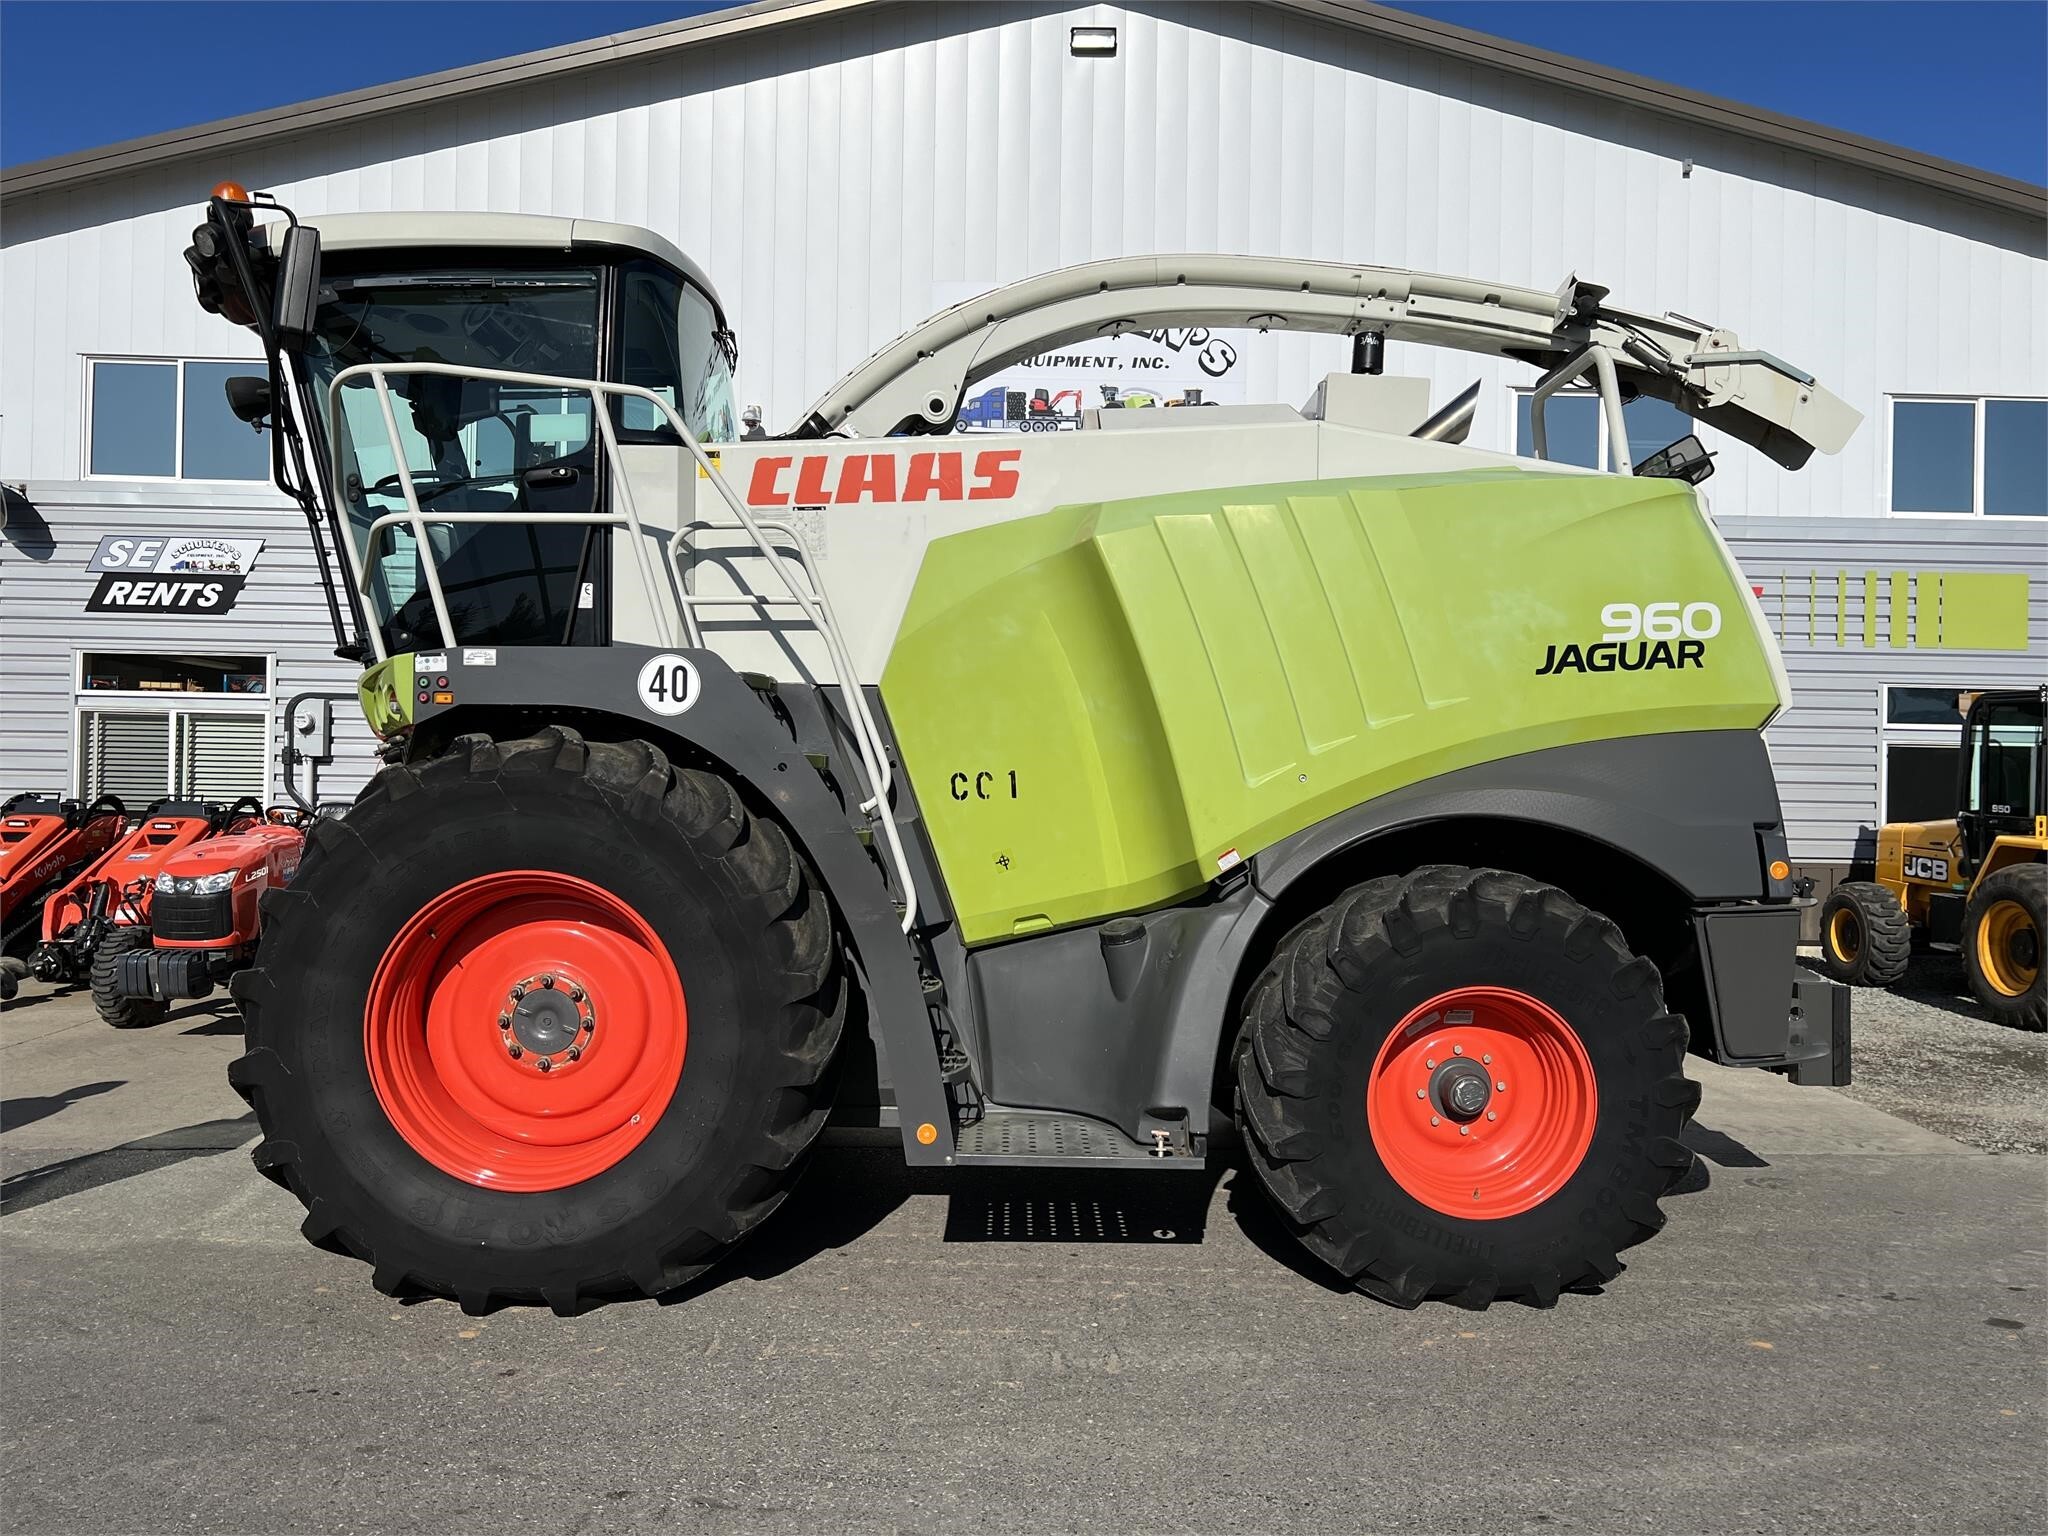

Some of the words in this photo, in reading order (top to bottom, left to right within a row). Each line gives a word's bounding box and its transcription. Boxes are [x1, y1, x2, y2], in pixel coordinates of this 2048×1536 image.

[1131, 356, 1170, 370] INC.
[747, 449, 1022, 506] CLAAS
[101, 538, 163, 568] SE
[171, 540, 242, 560] SCHOLTEN'S
[102, 580, 224, 608] RENTS
[1601, 601, 1722, 642] 960
[1535, 639, 1706, 676] JAGUAR
[648, 664, 689, 703] 40
[1991, 804, 2011, 814] 950
[34, 854, 66, 879] Kubota
[245, 866, 269, 882] L2501
[1904, 856, 1948, 881] JCB
